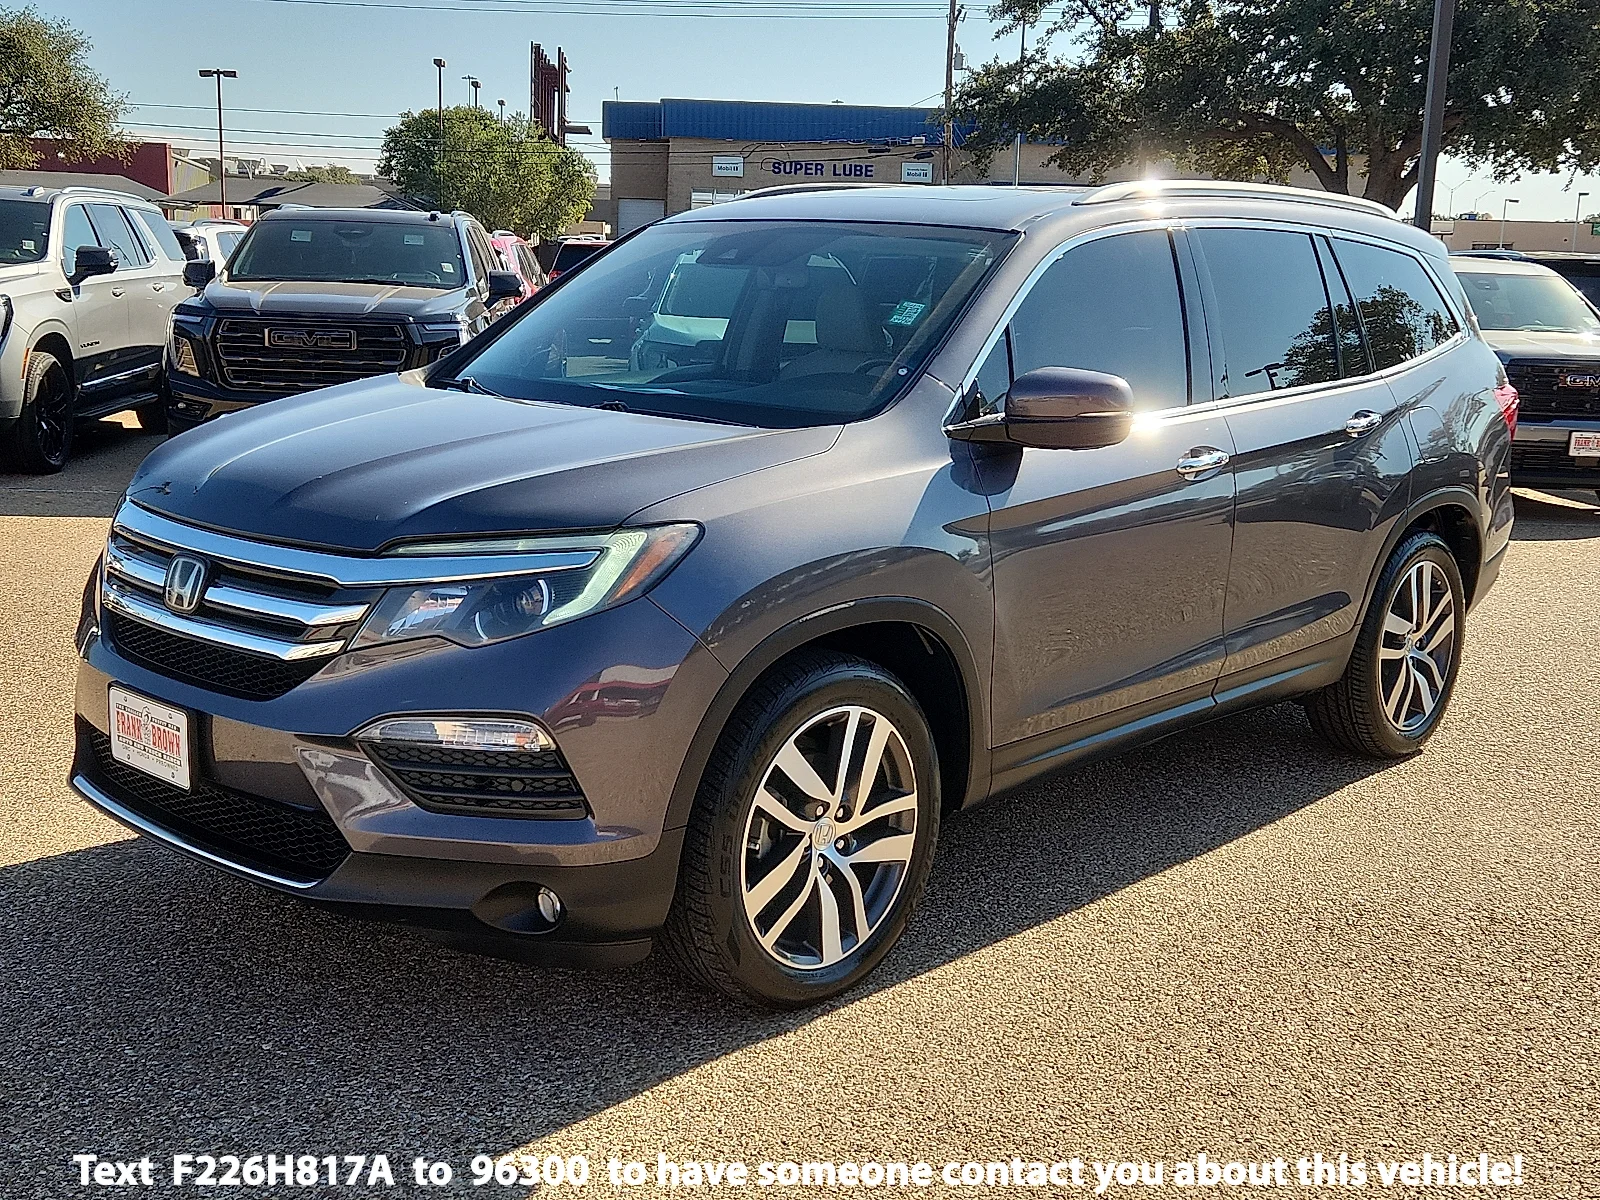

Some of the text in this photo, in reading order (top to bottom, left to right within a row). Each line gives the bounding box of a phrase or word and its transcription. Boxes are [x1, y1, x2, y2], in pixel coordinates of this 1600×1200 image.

[771, 161, 874, 178] SUPER LUBE
[270, 330, 350, 347] GMC
[116, 710, 181, 759] FRANK BROWN
